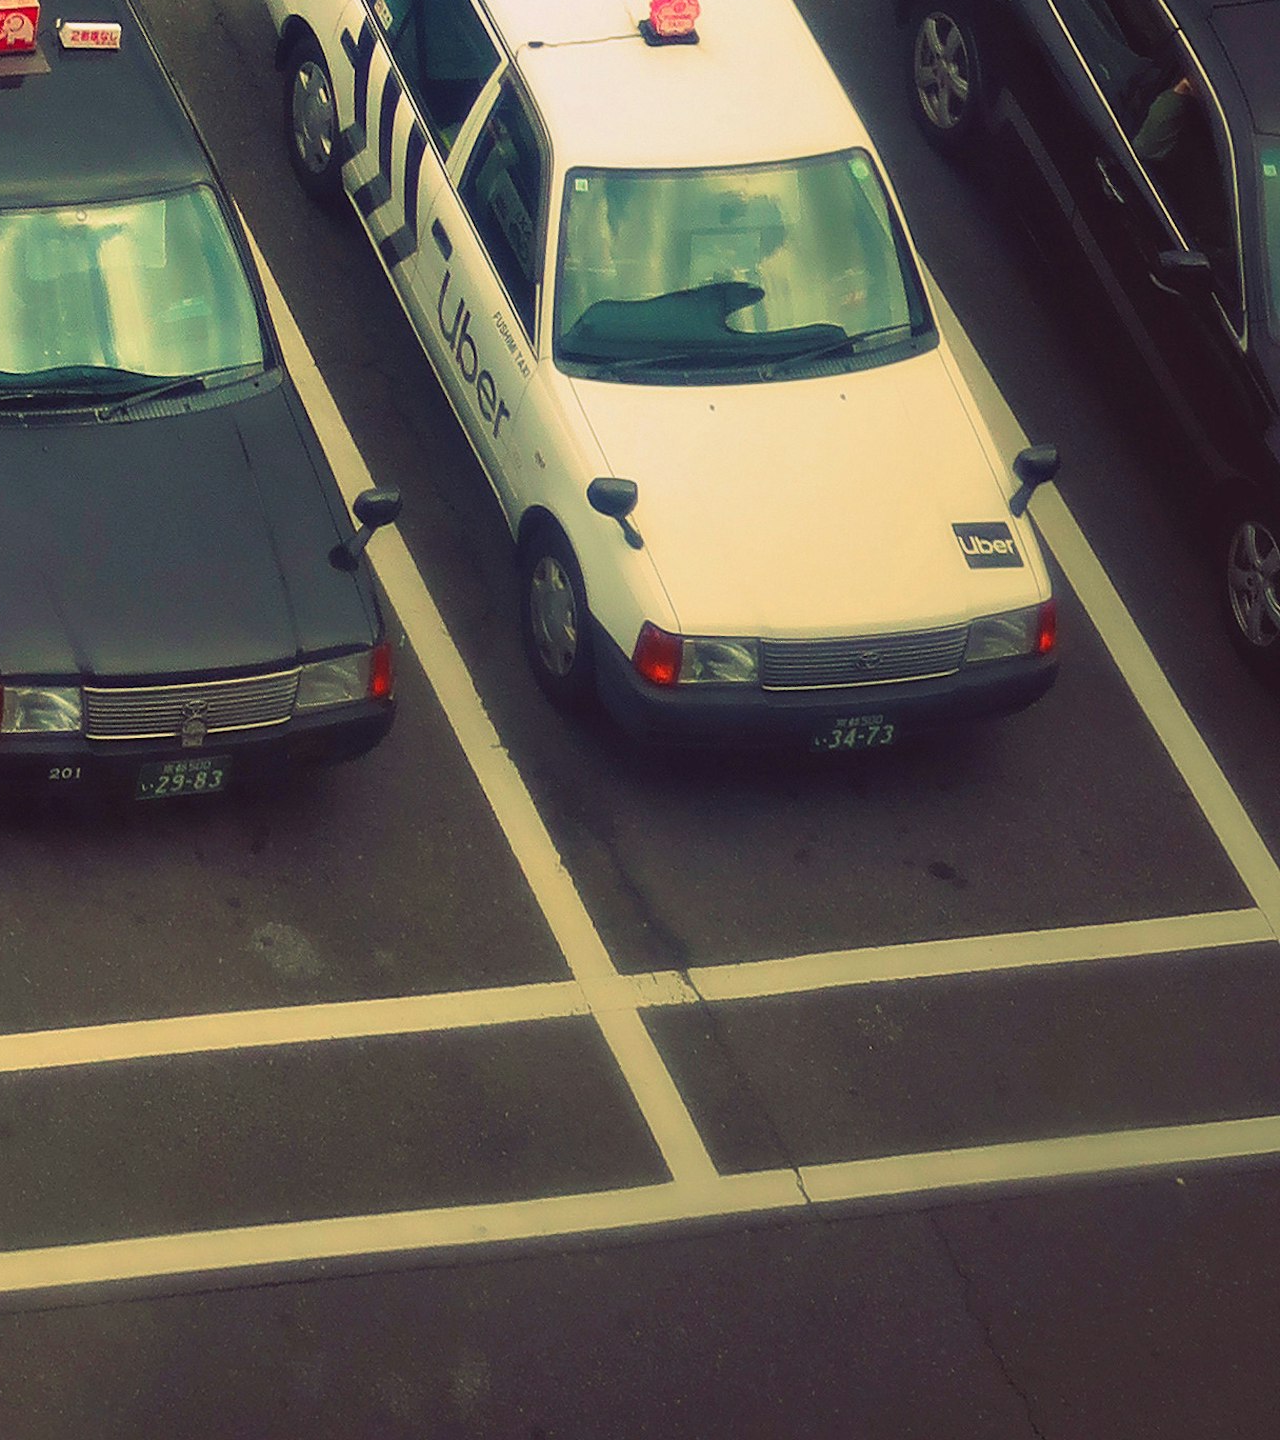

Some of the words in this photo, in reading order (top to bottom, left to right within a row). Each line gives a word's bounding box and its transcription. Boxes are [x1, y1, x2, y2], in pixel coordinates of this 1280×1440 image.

[437, 269, 511, 440] Uber
[493, 310, 518, 354] FUSHIMI
[516, 351, 531, 380] TAXI
[957, 535, 1017, 555] Uber
[828, 724, 894, 749] 34-73
[49, 767, 81, 780] 201
[154, 769, 223, 794] 29-83
